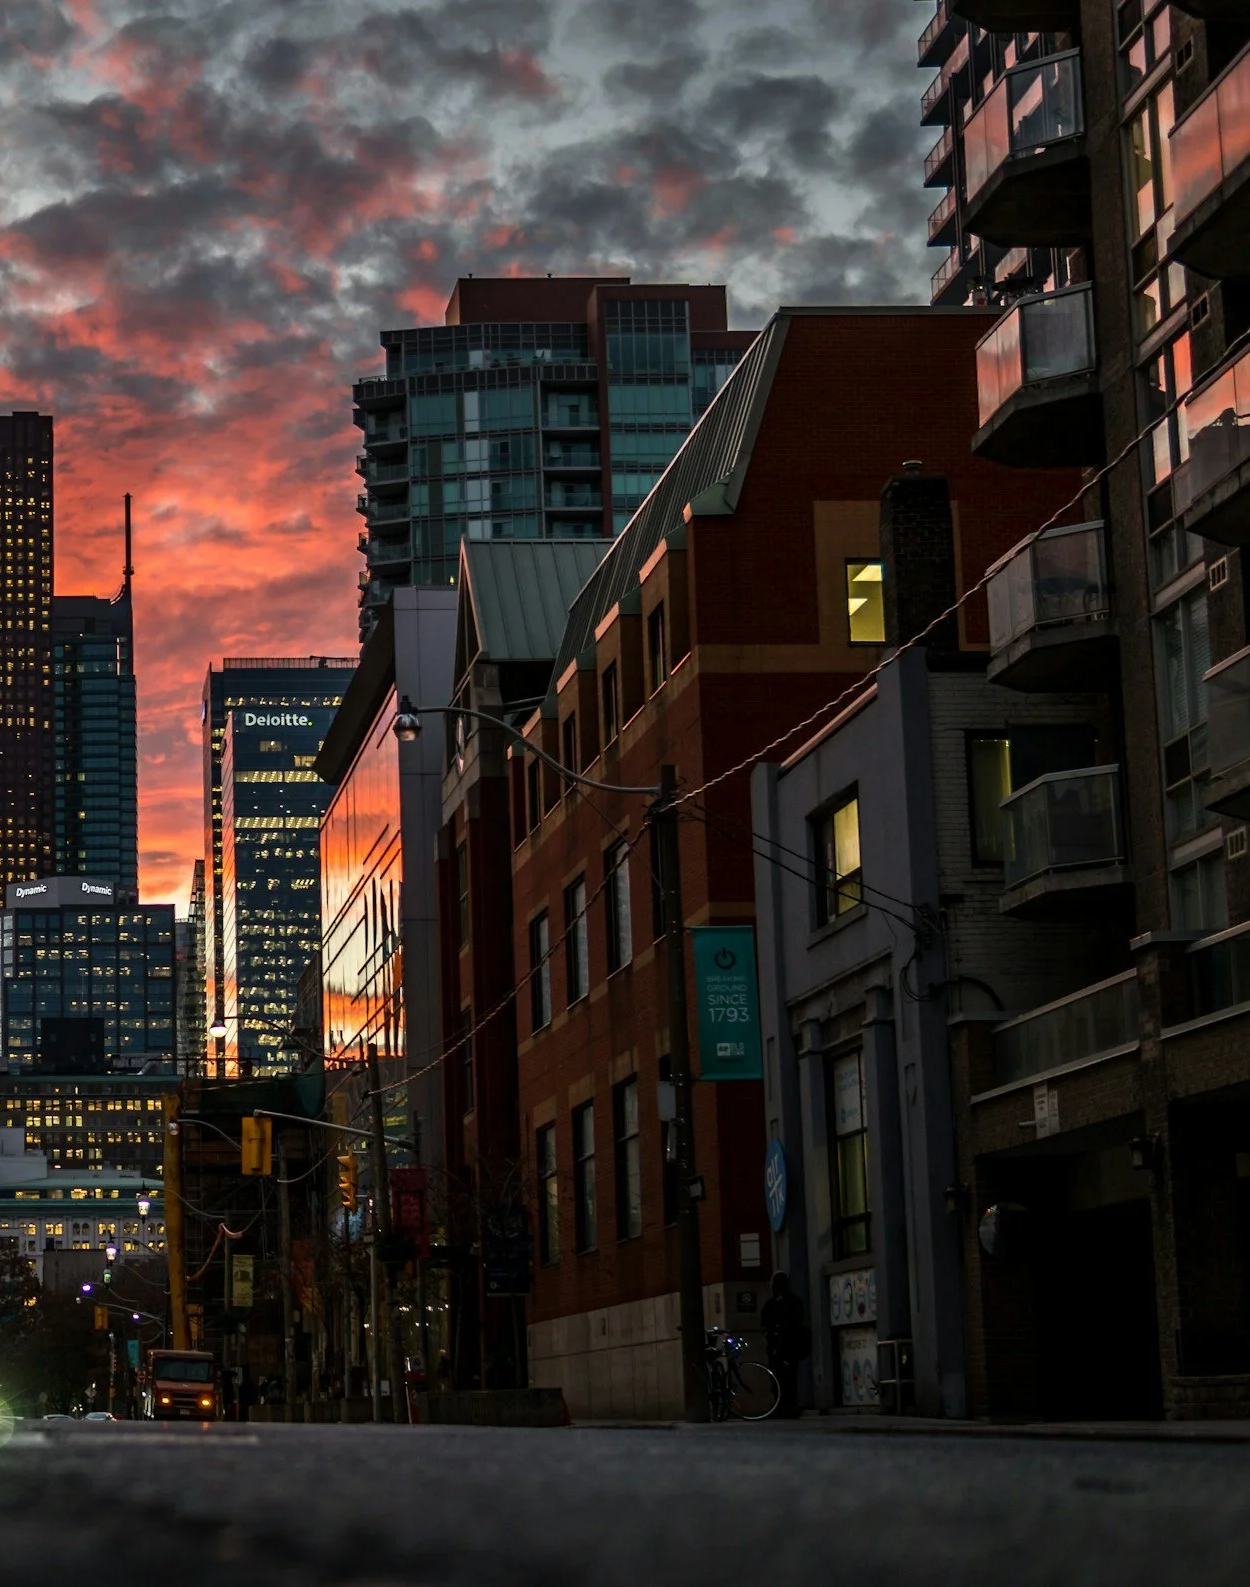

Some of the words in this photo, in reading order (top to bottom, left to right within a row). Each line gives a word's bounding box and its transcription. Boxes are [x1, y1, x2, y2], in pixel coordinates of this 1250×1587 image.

[245, 713, 313, 727] Deloitte.
[16, 885, 47, 898] Dynamic
[81, 882, 112, 896] Dynamic
[707, 993, 748, 1006] SINCE
